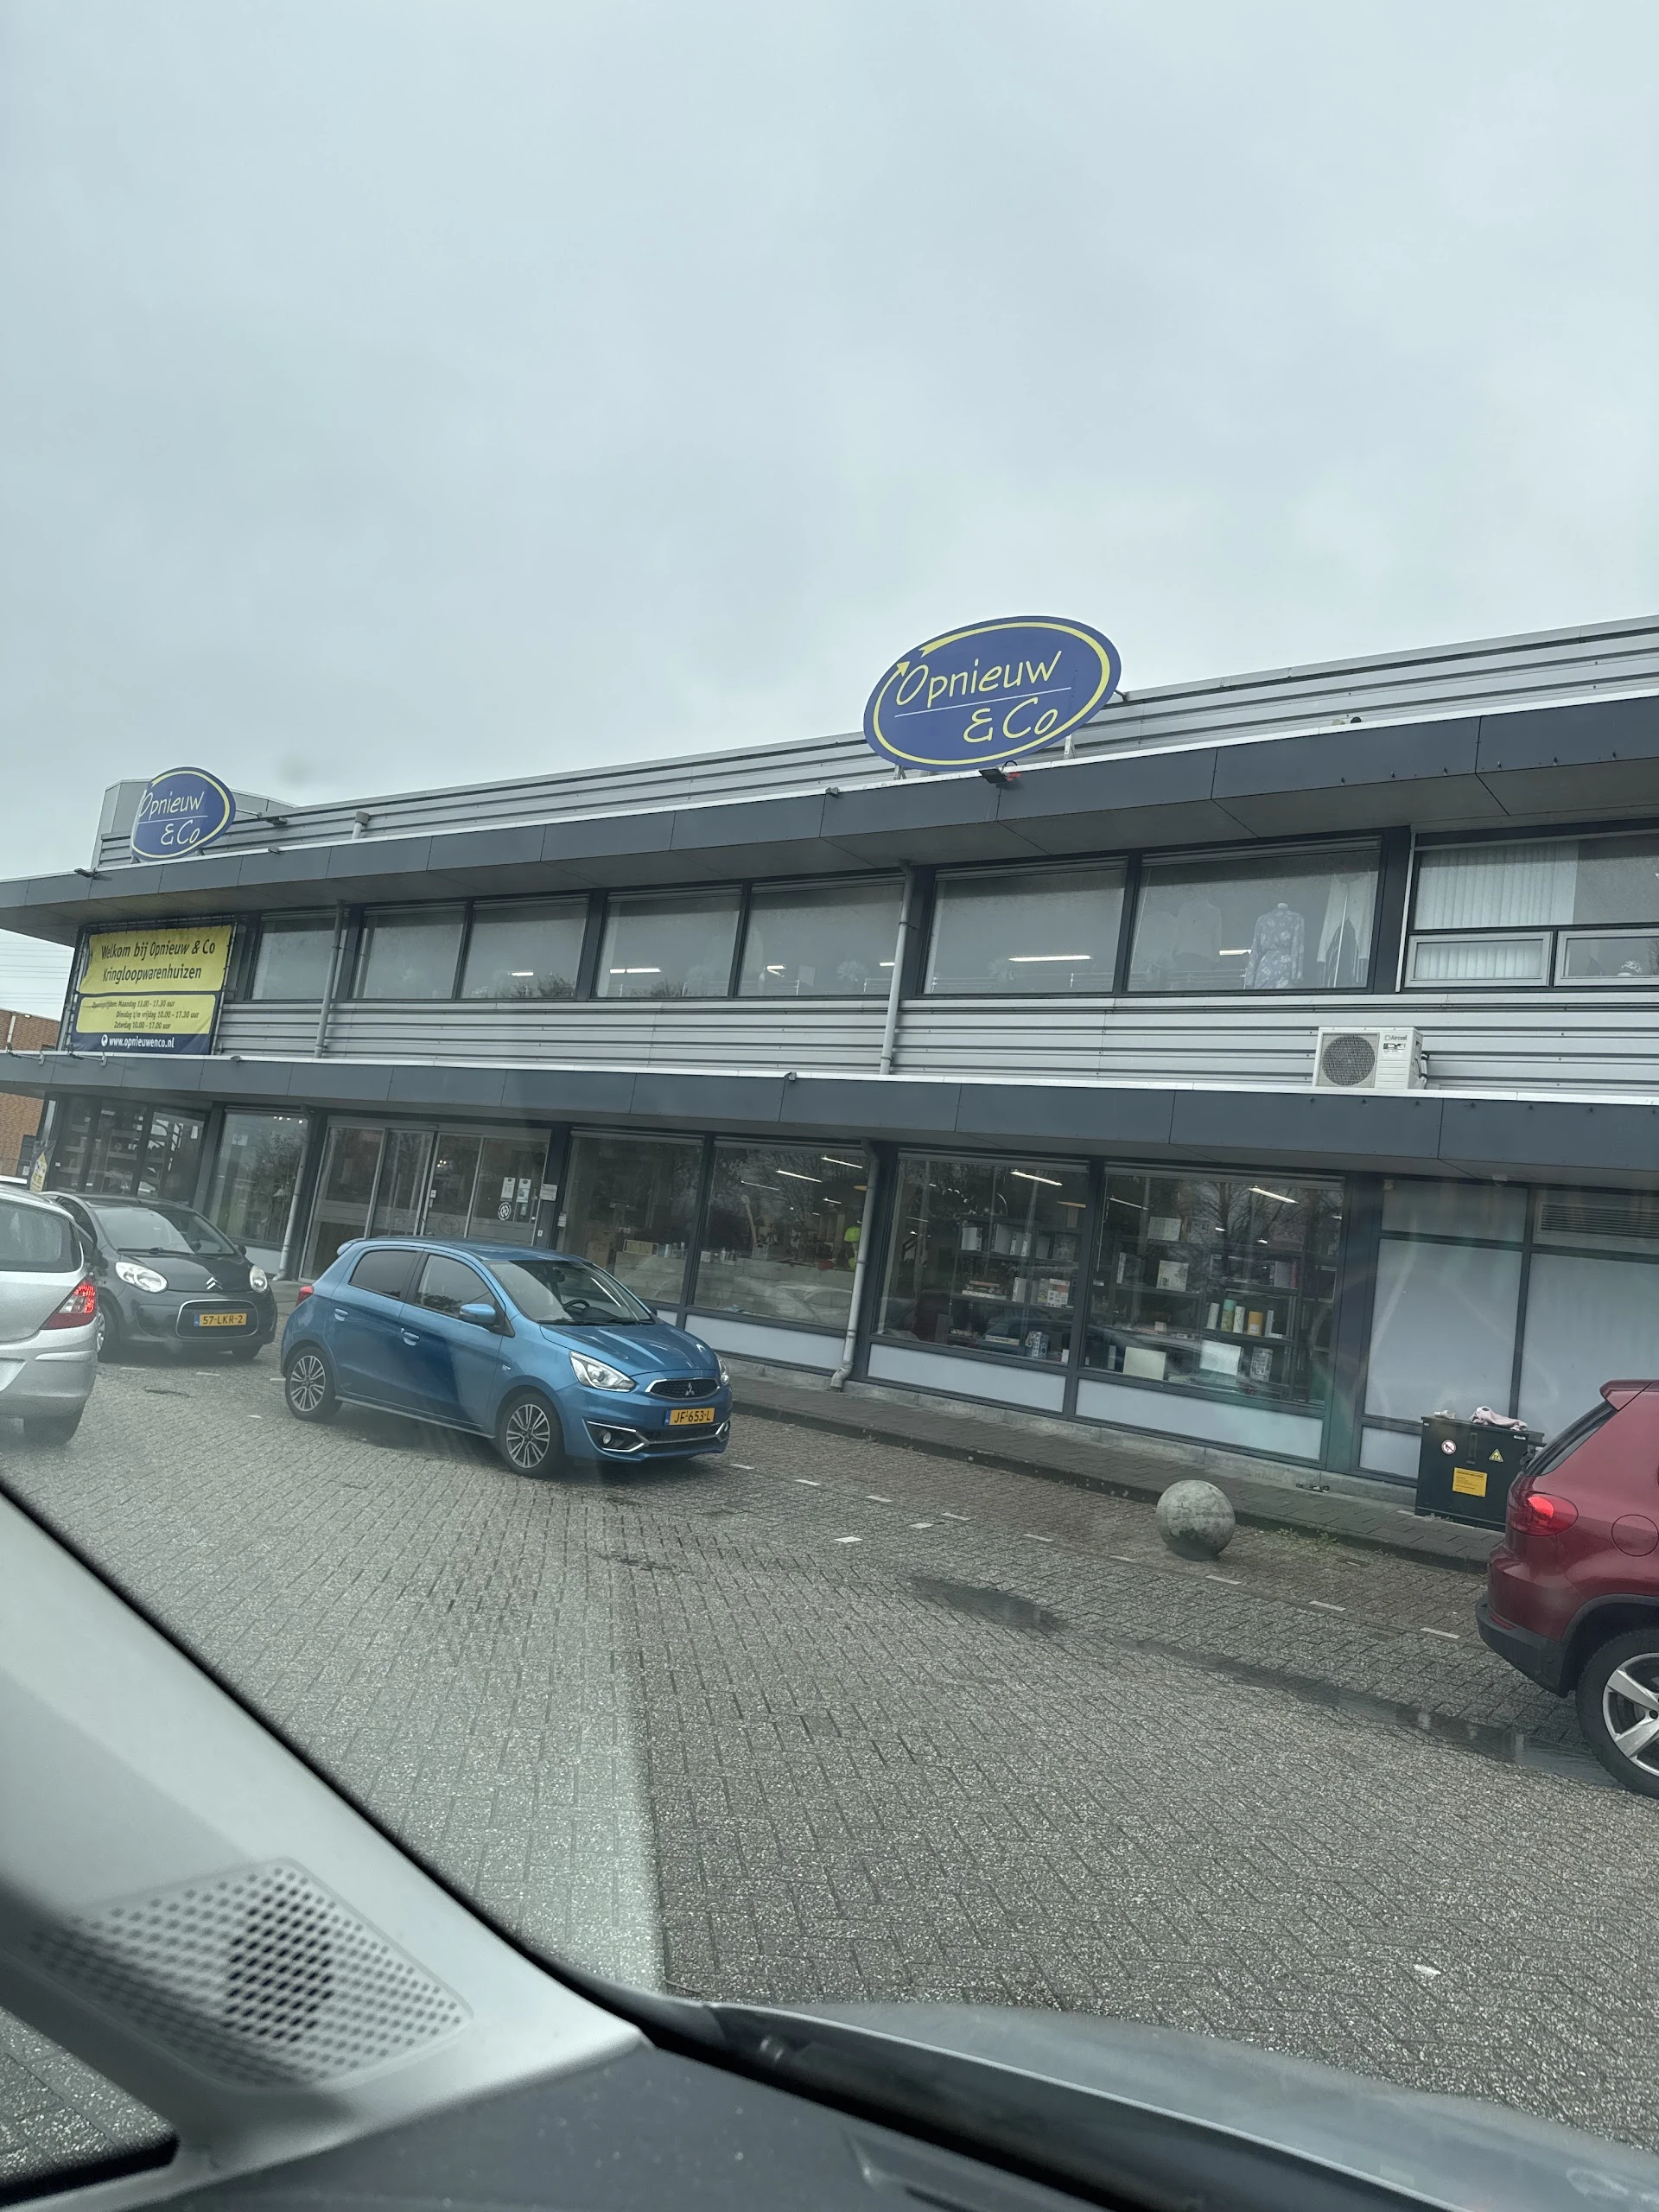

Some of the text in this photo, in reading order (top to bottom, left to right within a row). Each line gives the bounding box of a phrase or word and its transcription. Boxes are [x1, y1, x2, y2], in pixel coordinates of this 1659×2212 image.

[895, 650, 1063, 709] Opnieuw
[963, 696, 1058, 744] & Co
[138, 790, 206, 821] Opnieuw
[160, 819, 201, 846] & Co
[101, 938, 215, 961] Welkom bij Opnieuw & Co
[102, 963, 202, 985] Kringloopwarenhuizen
[116, 1011, 132, 1020] Dinsdag
[142, 1011, 156, 1020] vrijdag
[118, 1001, 137, 1009] Maandag
[114, 1021, 131, 1030] Zaterdag
[109, 1035, 175, 1049] www.opnieuwenco.nl
[202, 1314, 243, 1325] 57-LKR-2
